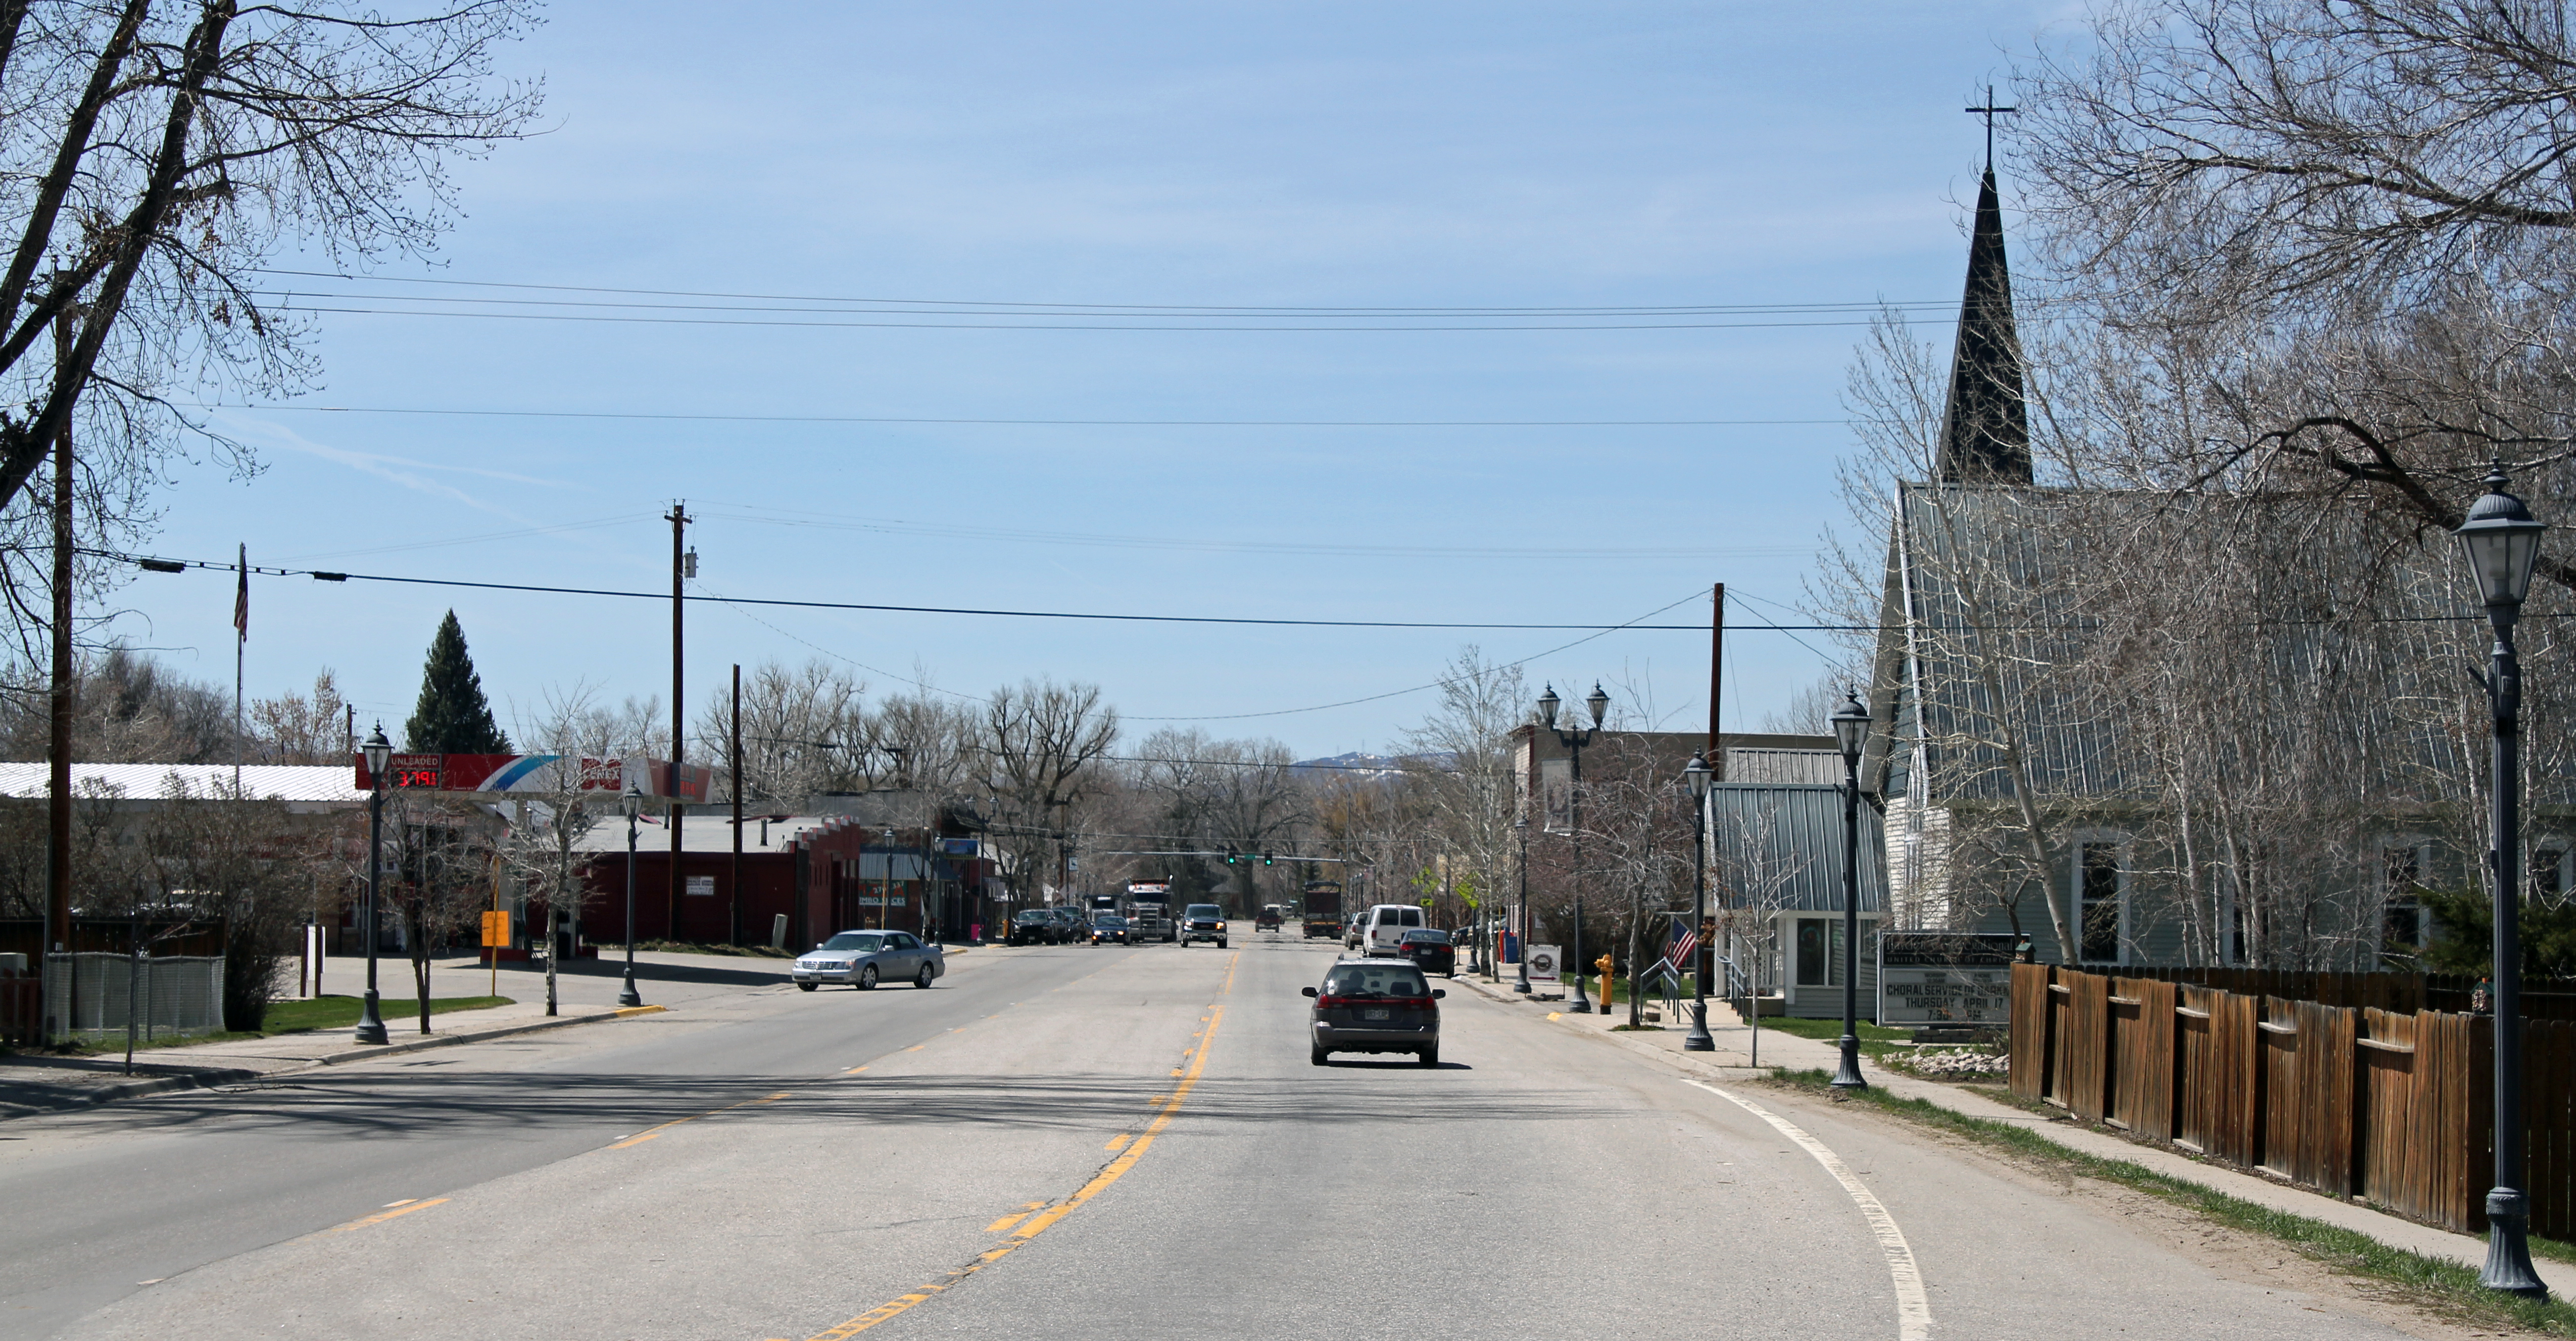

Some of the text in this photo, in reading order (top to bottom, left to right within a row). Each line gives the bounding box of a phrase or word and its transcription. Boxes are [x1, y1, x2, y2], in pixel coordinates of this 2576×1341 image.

[1886, 985, 1923, 995] CHORAL
[1925, 985, 1962, 996] SERVICE
[1964, 985, 1975, 996] OF
[1906, 997, 2003, 1008] THURSDAY APRIL 17
[1928, 1010, 1981, 1021] 7:30 PM
